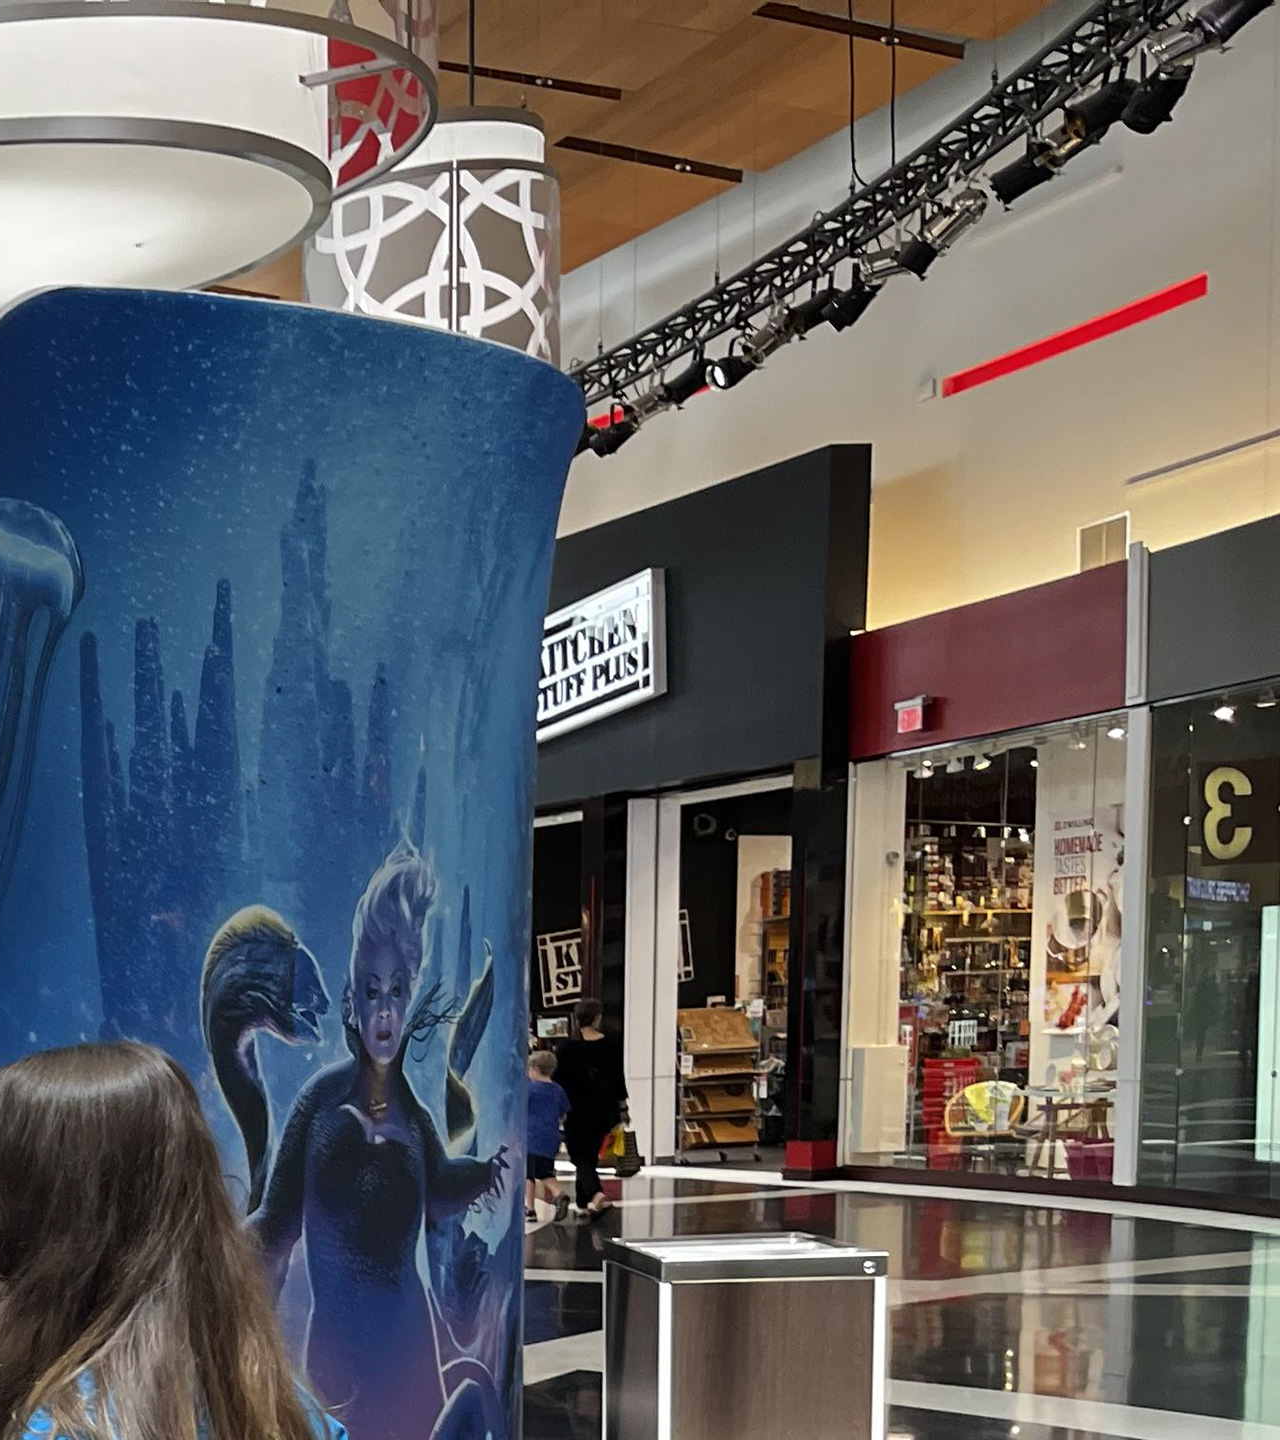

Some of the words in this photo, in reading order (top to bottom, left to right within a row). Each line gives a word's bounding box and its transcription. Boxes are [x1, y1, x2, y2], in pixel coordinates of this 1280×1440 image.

[538, 668, 587, 712] TUFF
[592, 647, 639, 691] PLUS
[1054, 832, 1103, 856] HOMEMADE
[1053, 855, 1087, 875] TASTES
